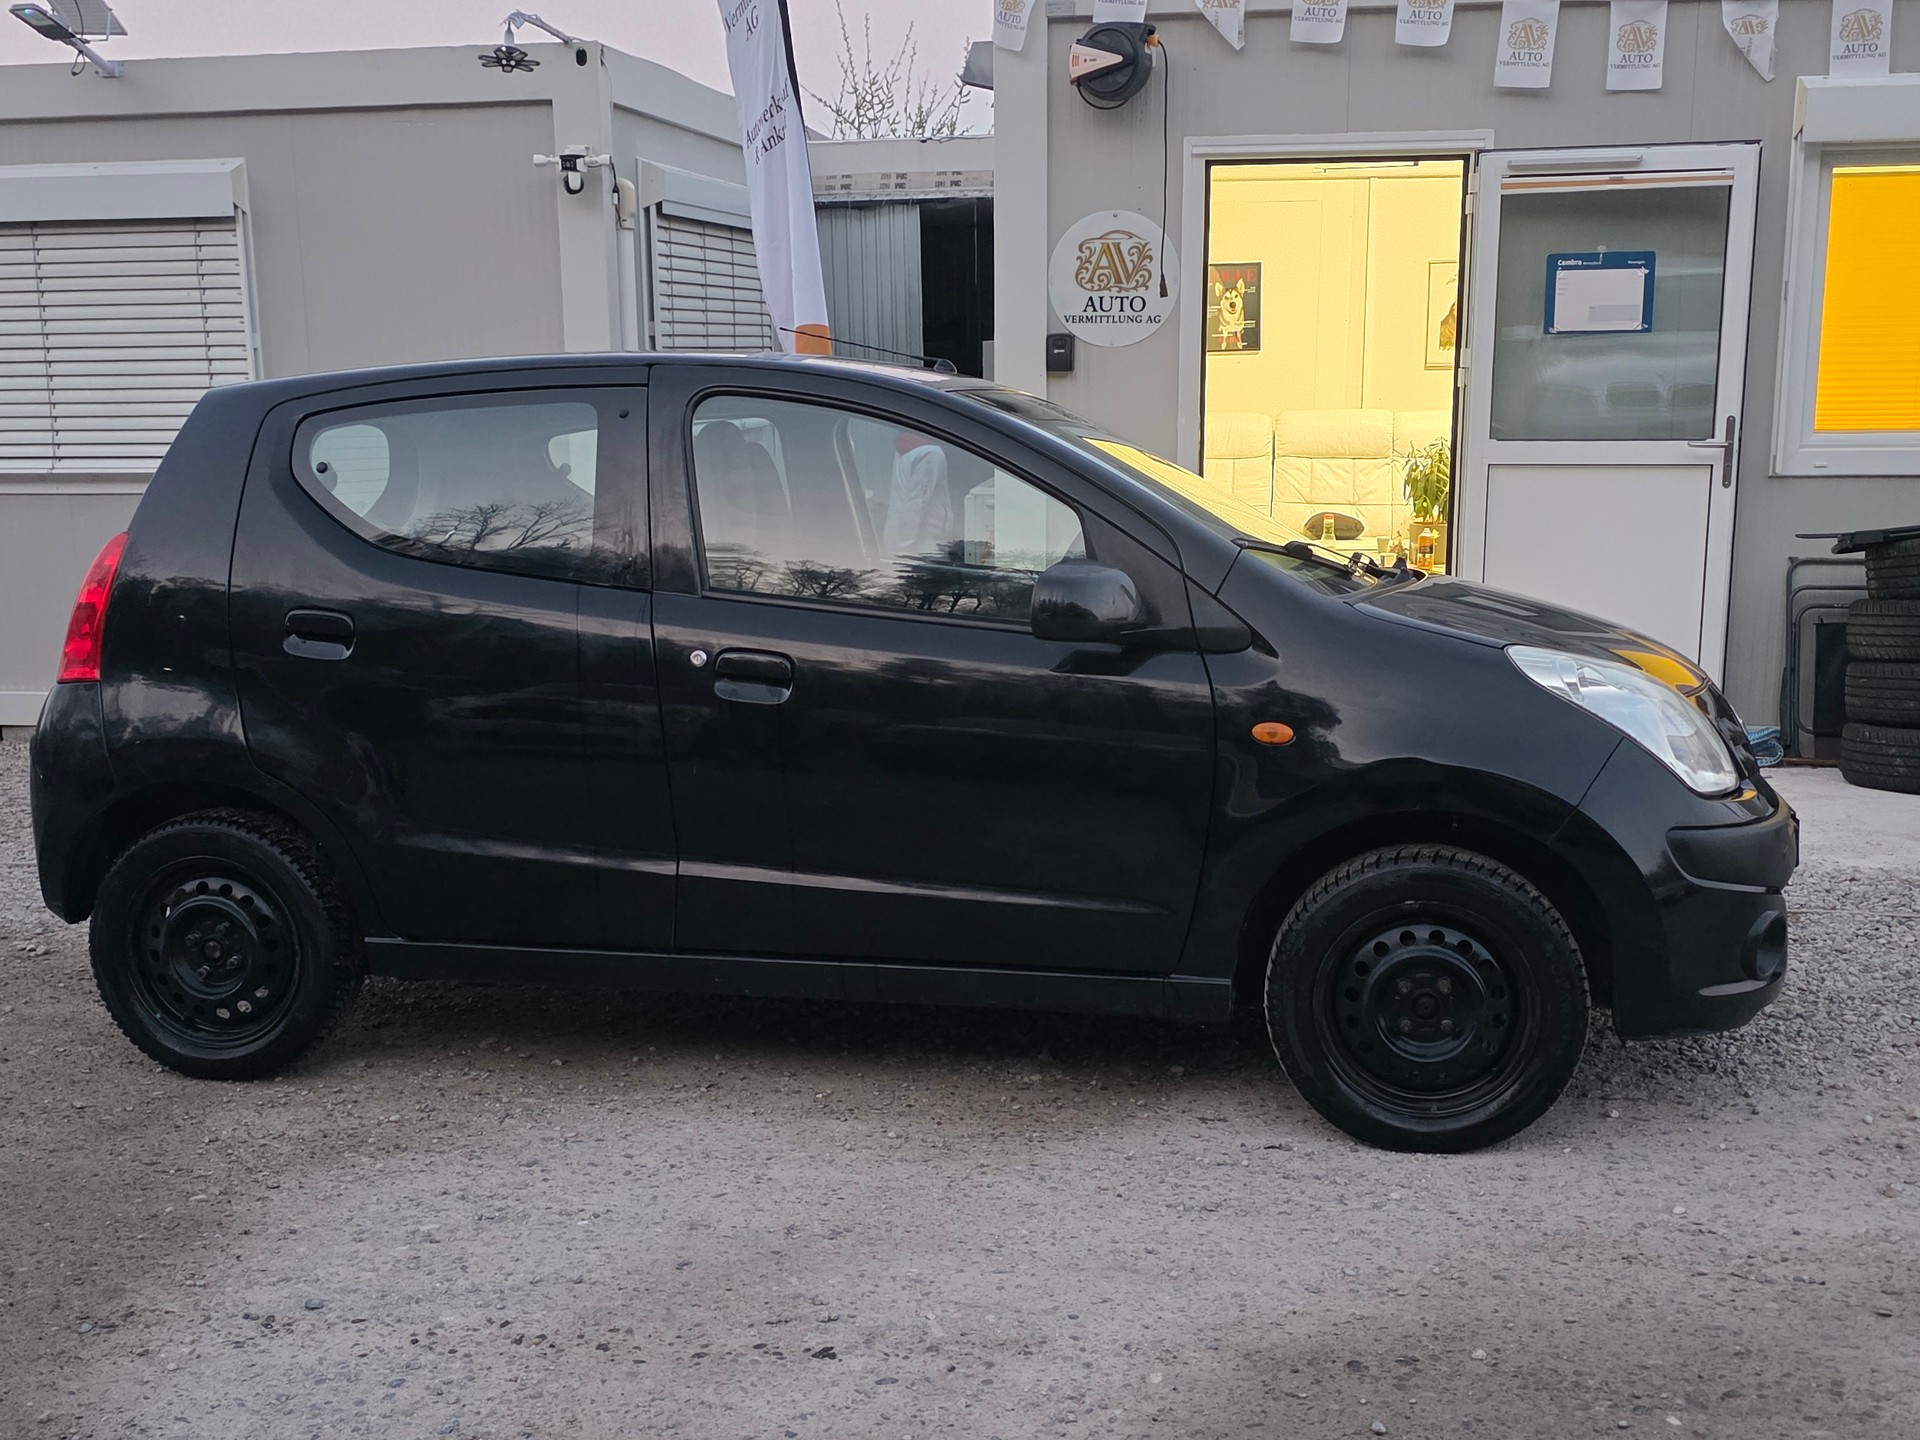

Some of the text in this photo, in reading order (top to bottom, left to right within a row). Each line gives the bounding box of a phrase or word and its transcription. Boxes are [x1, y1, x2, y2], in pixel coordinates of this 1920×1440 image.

[1304, 7, 1337, 17] AUTO
[1409, 9, 1443, 20] AUTO
[997, 10, 1022, 25] AUTO
[746, 5, 759, 41] AG
[1842, 43, 1879, 53] AUTO
[1509, 51, 1543, 61] AUTO
[1620, 53, 1653, 63] AUTO
[1557, 258, 1582, 266] Cembra
[1082, 296, 1147, 313] AUTO
[1064, 315, 1162, 324] VERMITTLUNG AG
